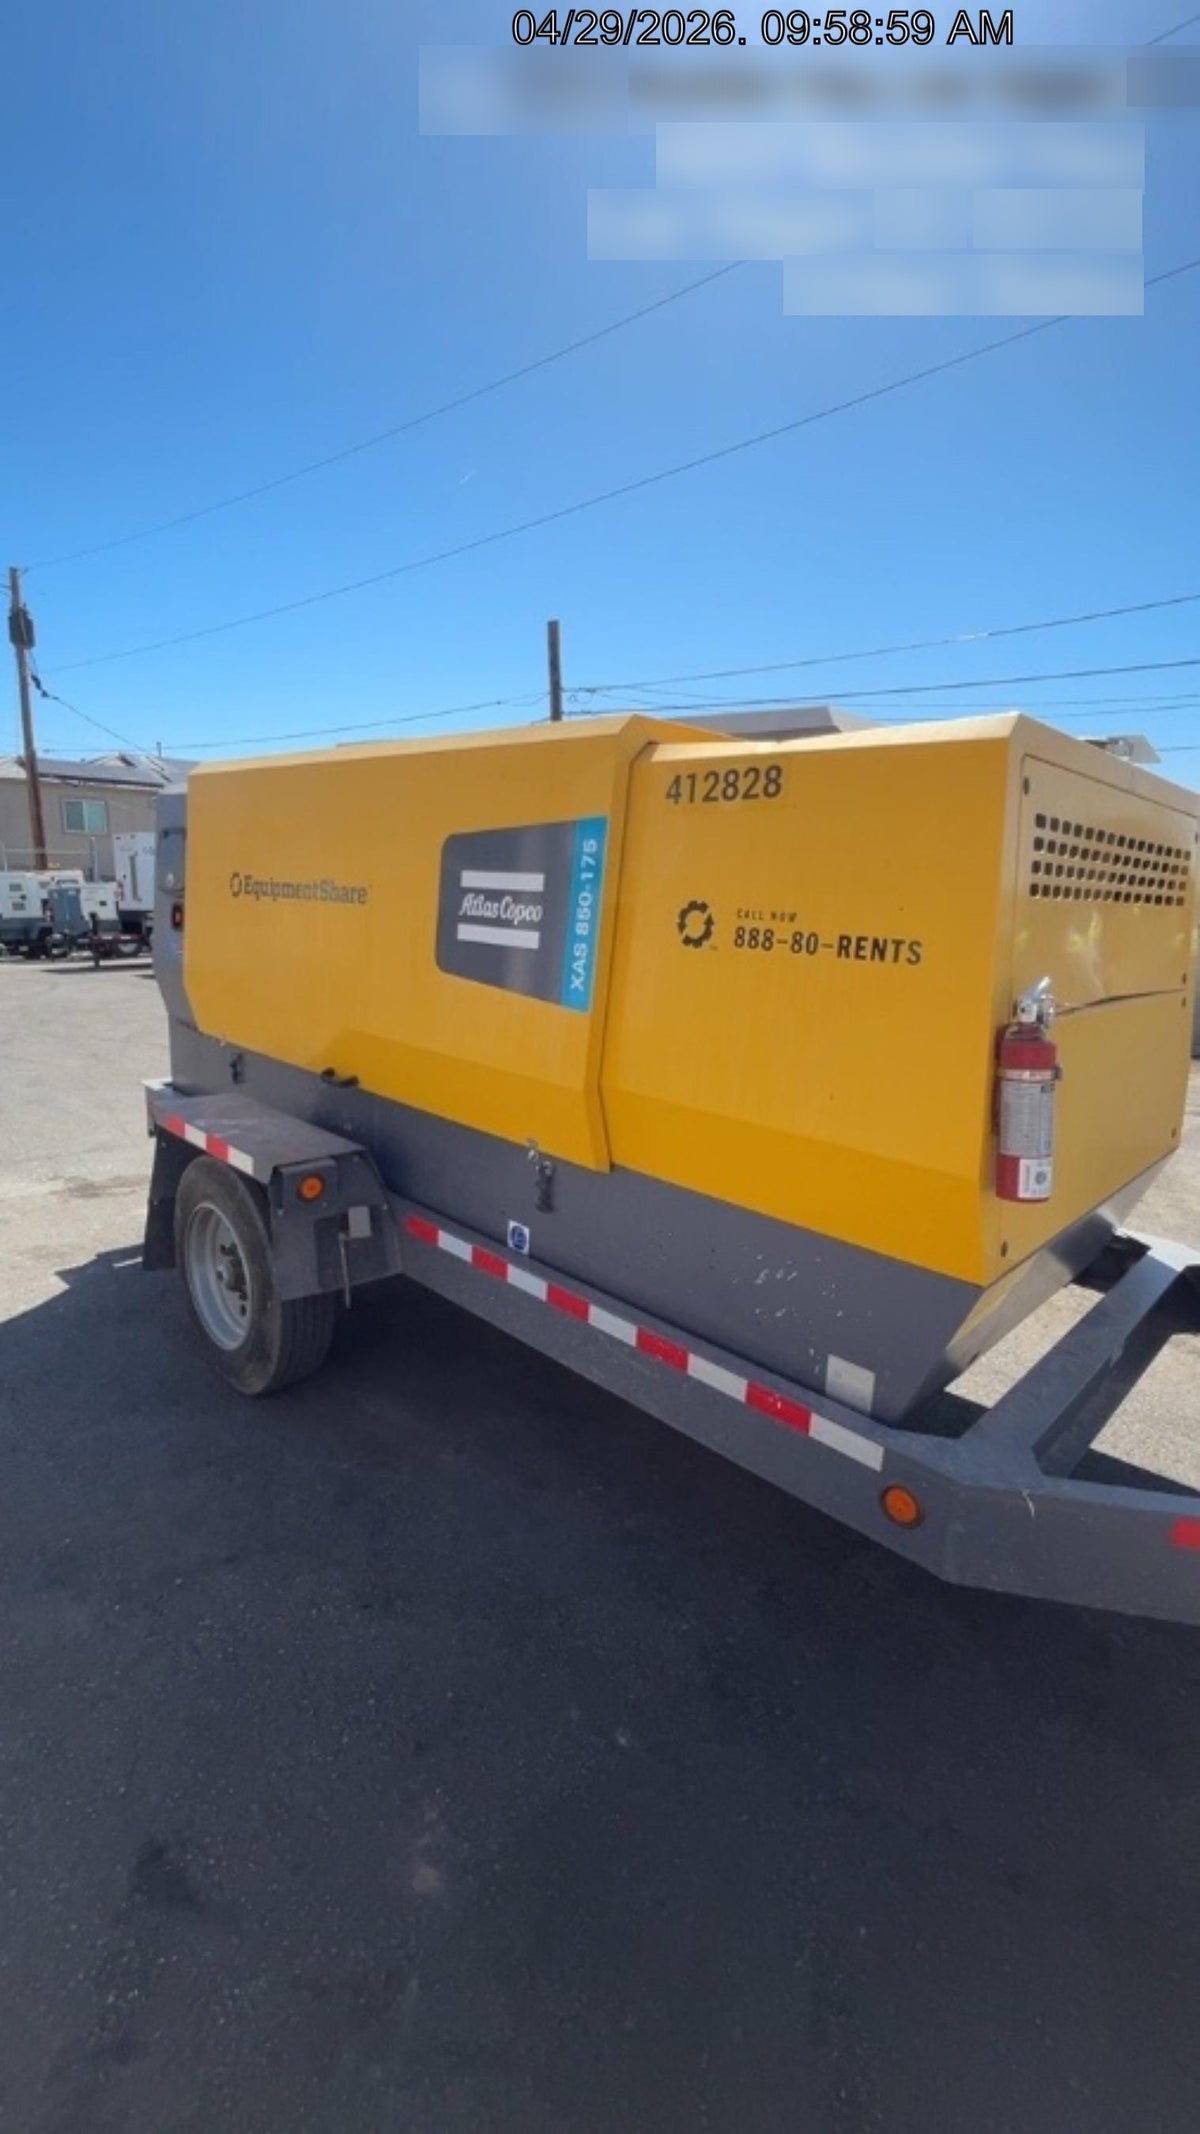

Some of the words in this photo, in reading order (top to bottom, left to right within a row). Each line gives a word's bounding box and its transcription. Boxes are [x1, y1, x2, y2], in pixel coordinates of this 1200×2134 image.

[666, 765, 783, 805] 412828
[244, 874, 368, 905] EquipmentShare
[575, 838, 599, 937] 850-175
[458, 893, 500, 918] Atlas
[500, 896, 543, 925] Copco
[737, 908, 765, 921] CALL
[770, 911, 798, 923] NOW
[734, 926, 924, 966] 888-80-RENTS
[570, 943, 589, 991] XAS
